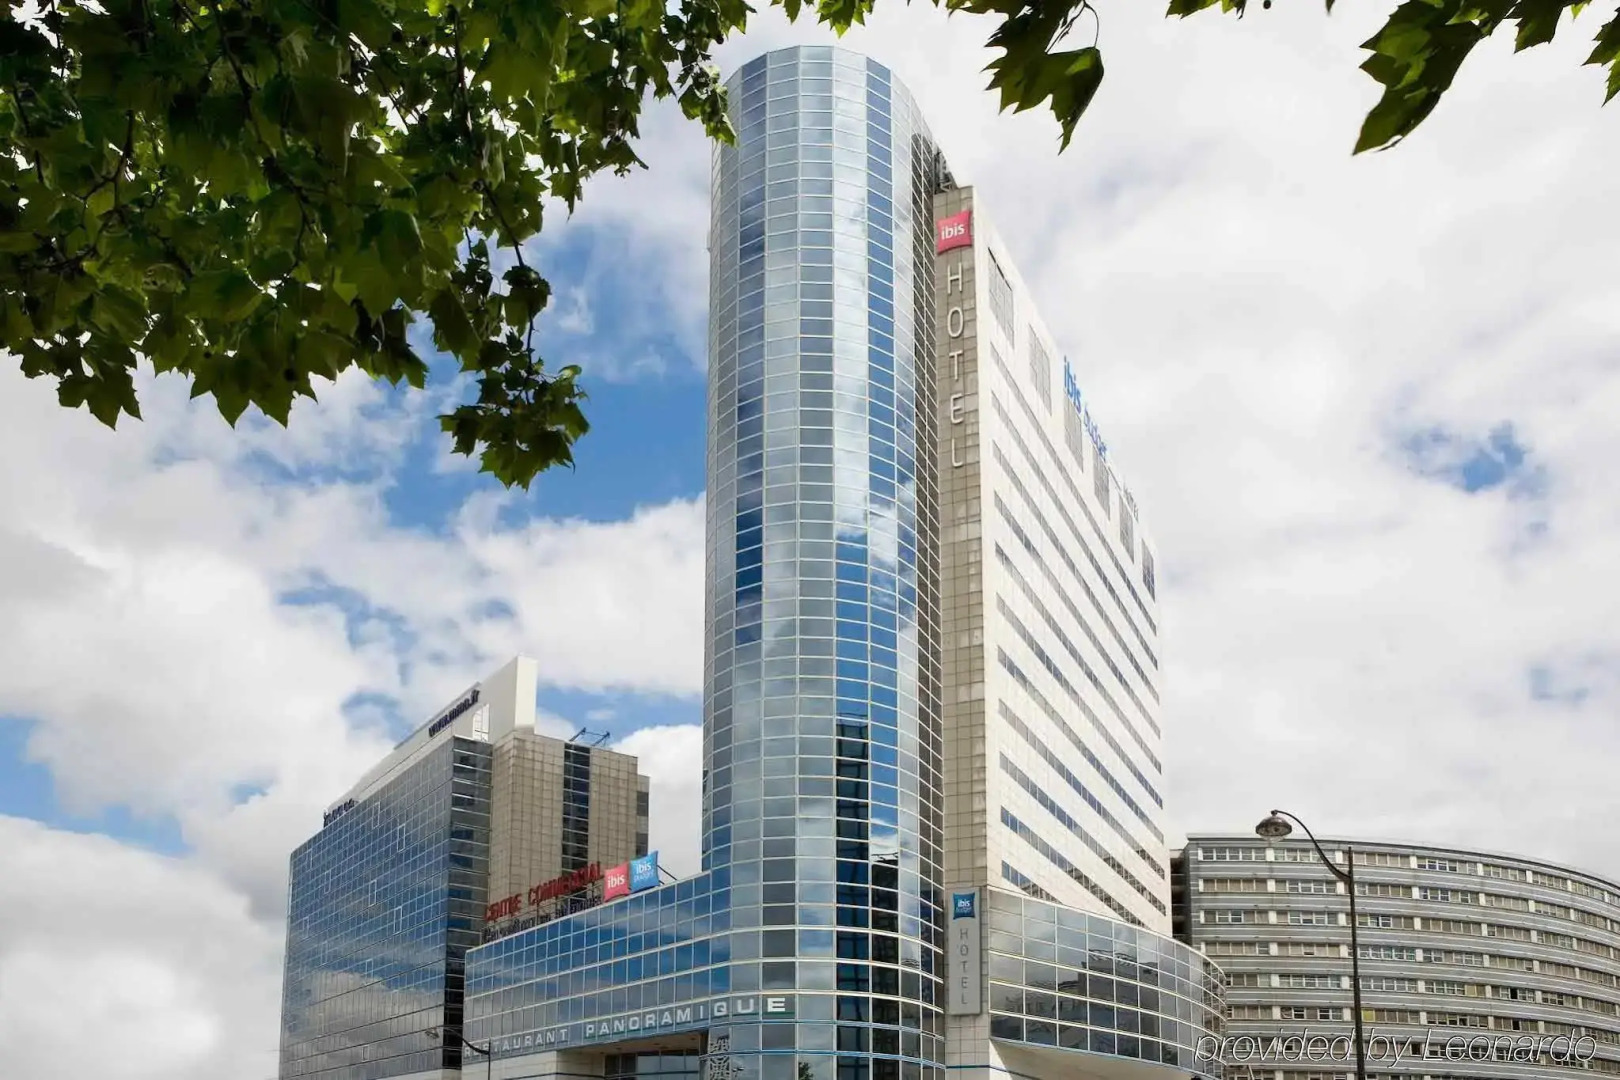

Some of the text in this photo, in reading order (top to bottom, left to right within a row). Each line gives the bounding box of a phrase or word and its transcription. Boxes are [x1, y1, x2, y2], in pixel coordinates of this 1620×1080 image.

[941, 222, 965, 240] ibis
[946, 264, 965, 468] HOTEL
[1064, 355, 1081, 414] ibis
[607, 873, 625, 889] ibis
[635, 861, 652, 874] ibis
[957, 899, 970, 907] ibis
[960, 927, 969, 1005] HOTEL
[586, 997, 786, 1037] PANORAMIQUE
